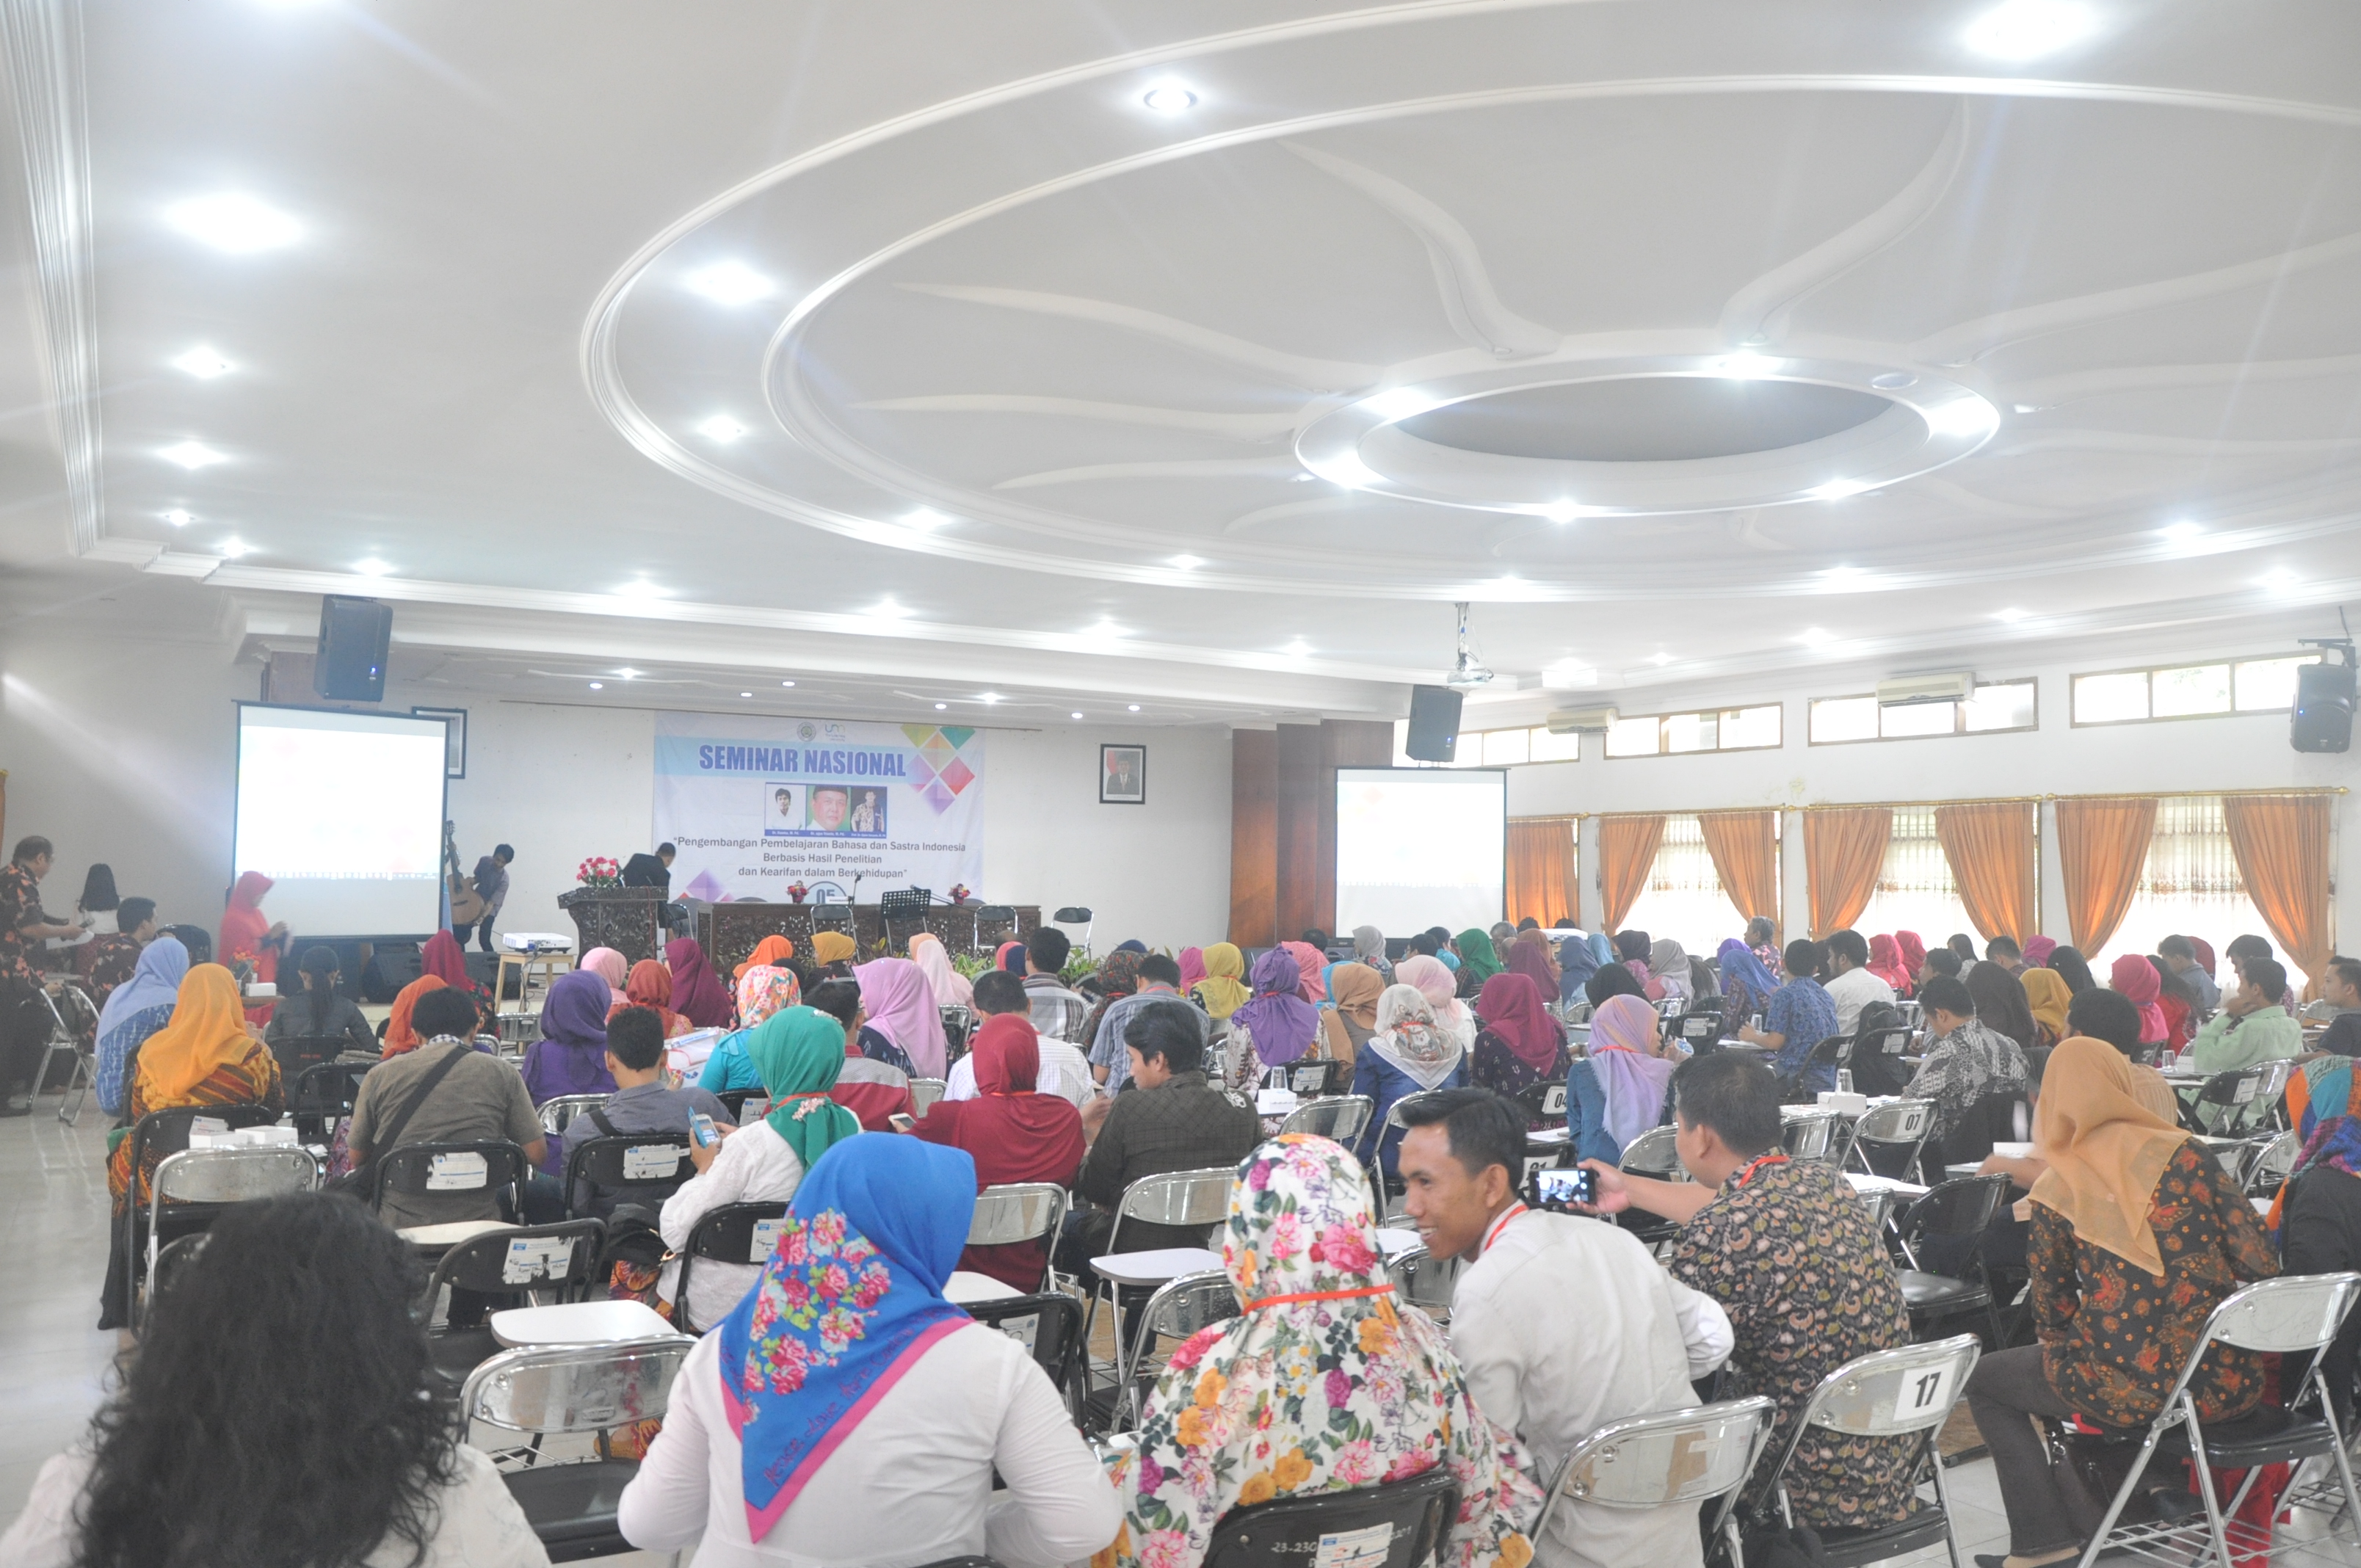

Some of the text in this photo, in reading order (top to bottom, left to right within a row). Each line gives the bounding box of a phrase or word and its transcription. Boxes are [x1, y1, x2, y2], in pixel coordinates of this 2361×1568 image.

[699, 744, 907, 777] SEMINAR NASIONAL
[673, 836, 966, 852] “Pengembangan Pembelajaran Bahasa dan Sastra Indonesia
[764, 852, 882, 863] Berbasis Hasil Penelitian
[739, 867, 757, 876] dan
[761, 867, 802, 876] Kearifan
[805, 868, 835, 876] dalam
[1905, 1114, 1921, 1131] 07
[1915, 1371, 1942, 1408] 17
